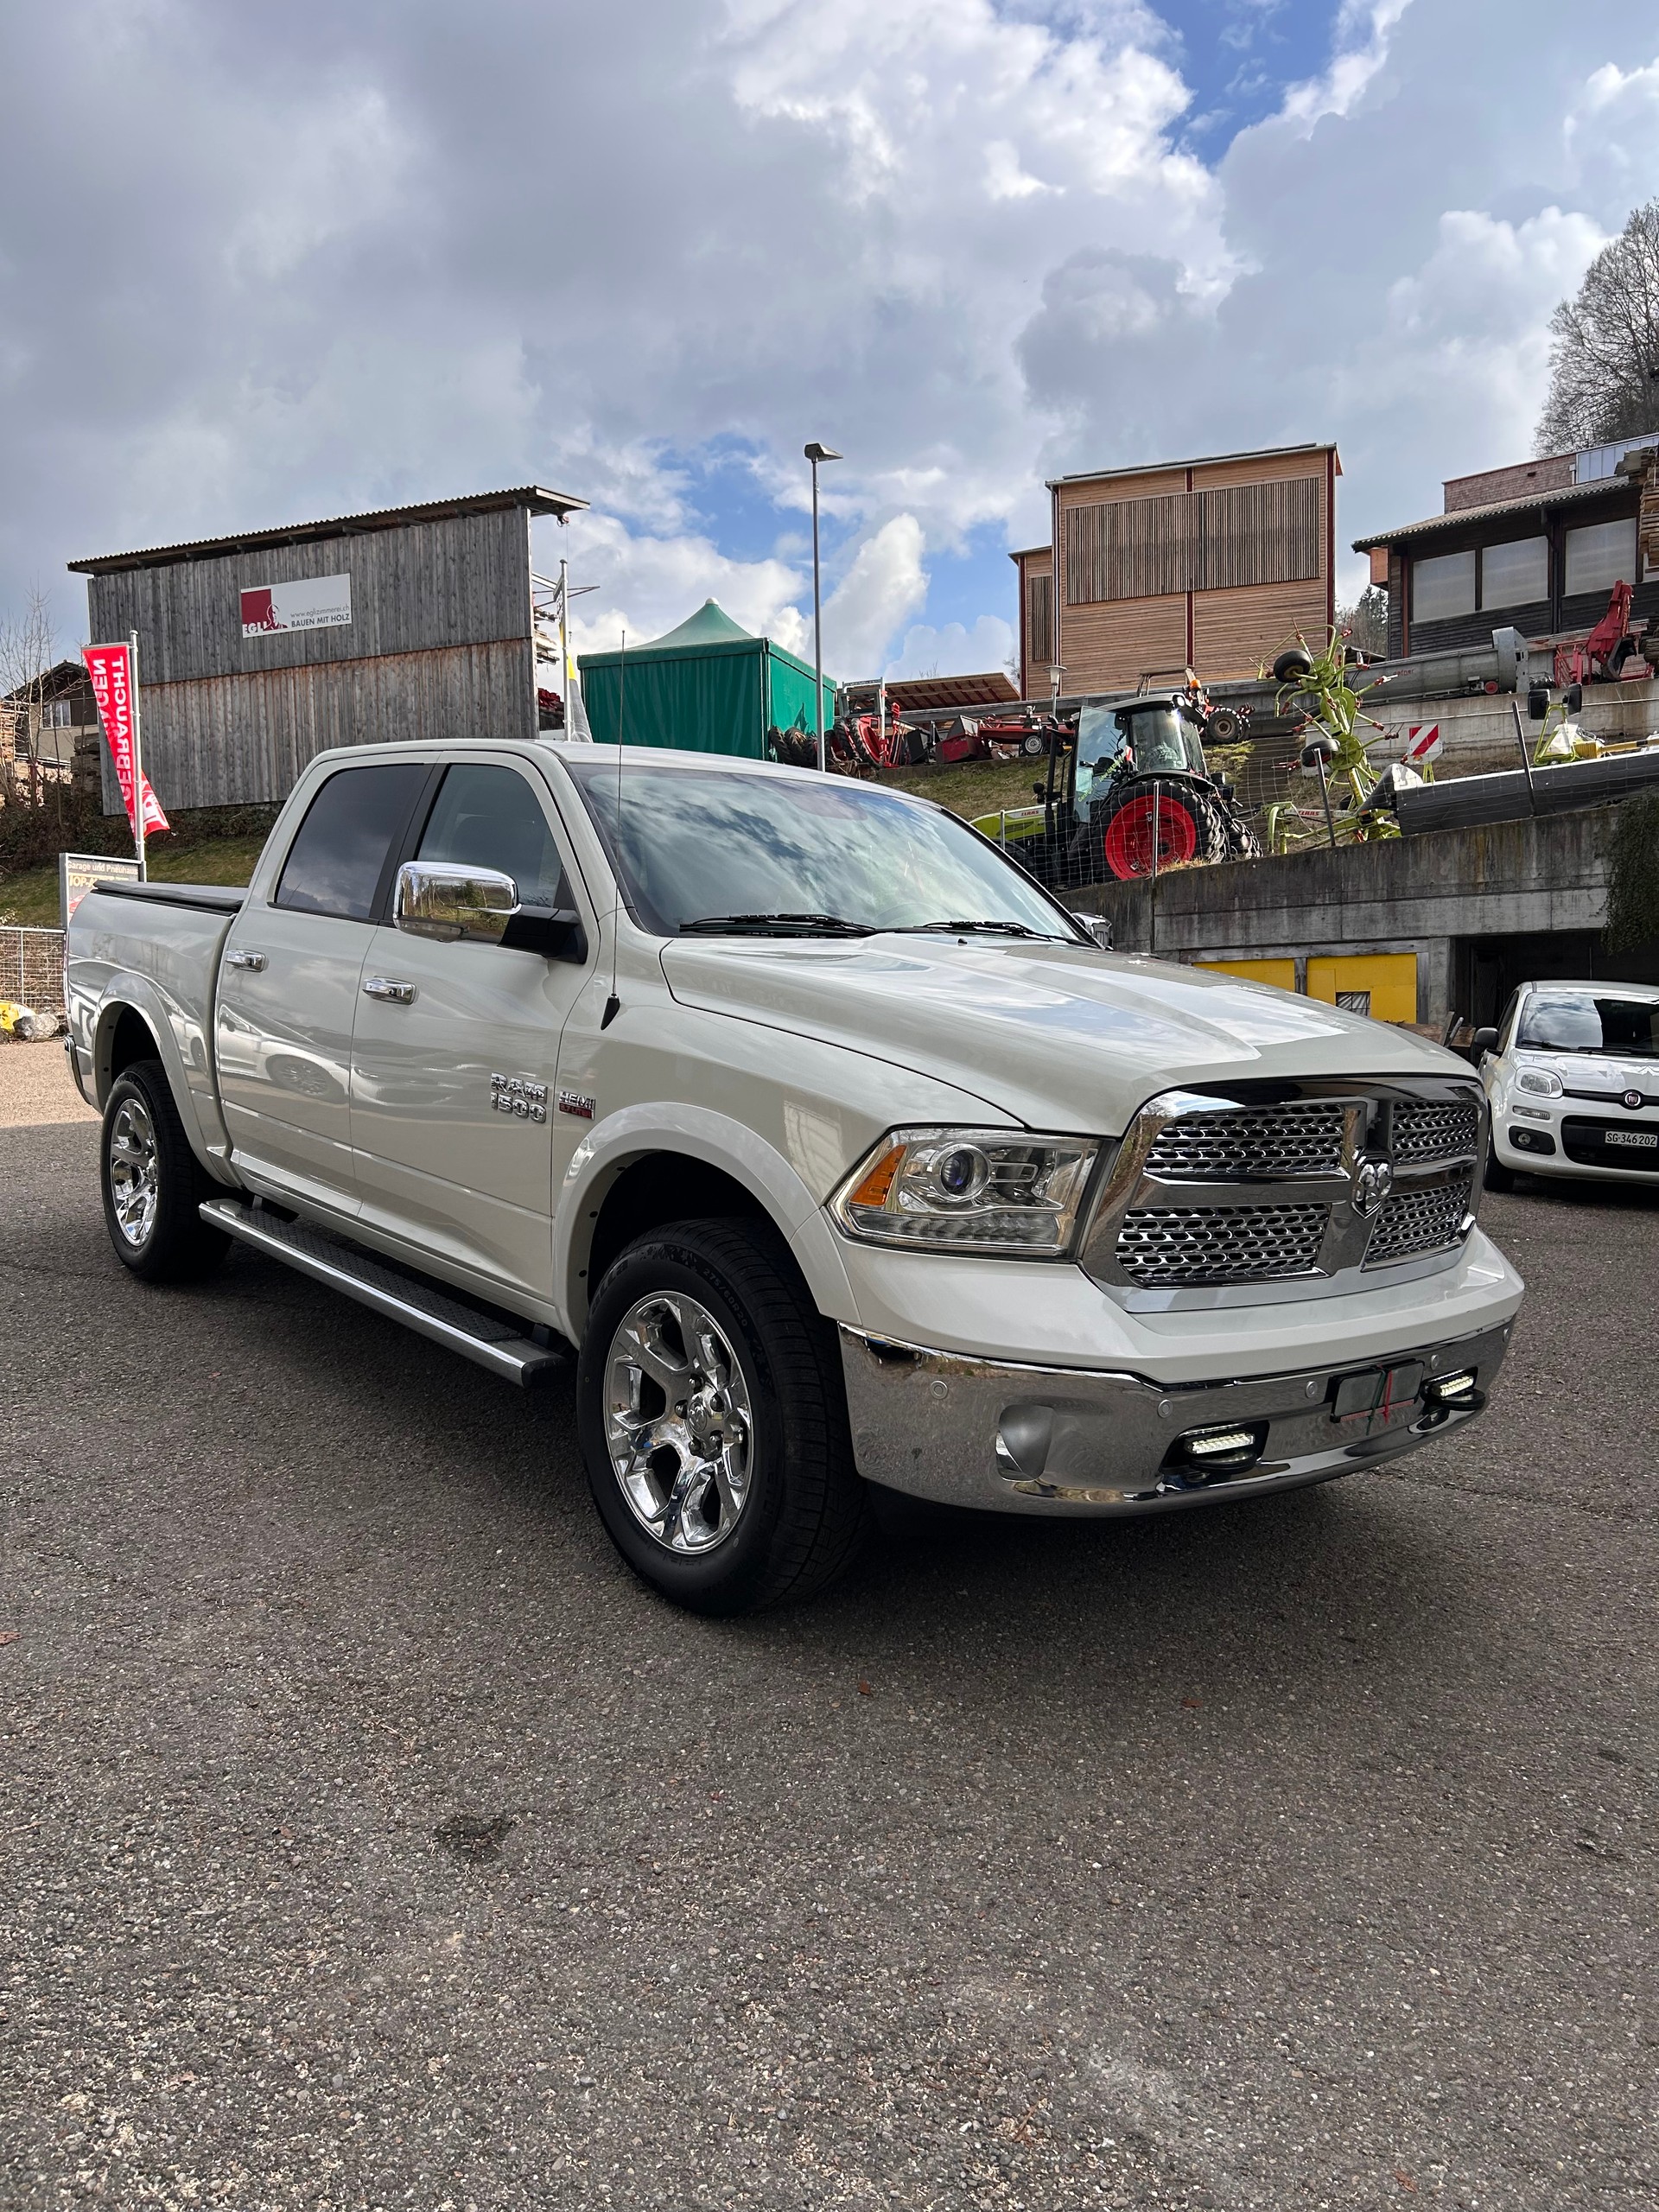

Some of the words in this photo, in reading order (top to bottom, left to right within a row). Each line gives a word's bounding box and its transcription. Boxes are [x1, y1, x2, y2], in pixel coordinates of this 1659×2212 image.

[290, 604, 350, 618] www.eglizimmerei.ch
[242, 620, 267, 634] EGLI
[291, 617, 315, 628] BAUEN
[316, 615, 329, 624] MIT
[331, 613, 350, 623] HOLZ
[491, 1072, 548, 1104] RAM
[490, 1091, 547, 1124] 1500
[559, 1090, 595, 1109] HEMI
